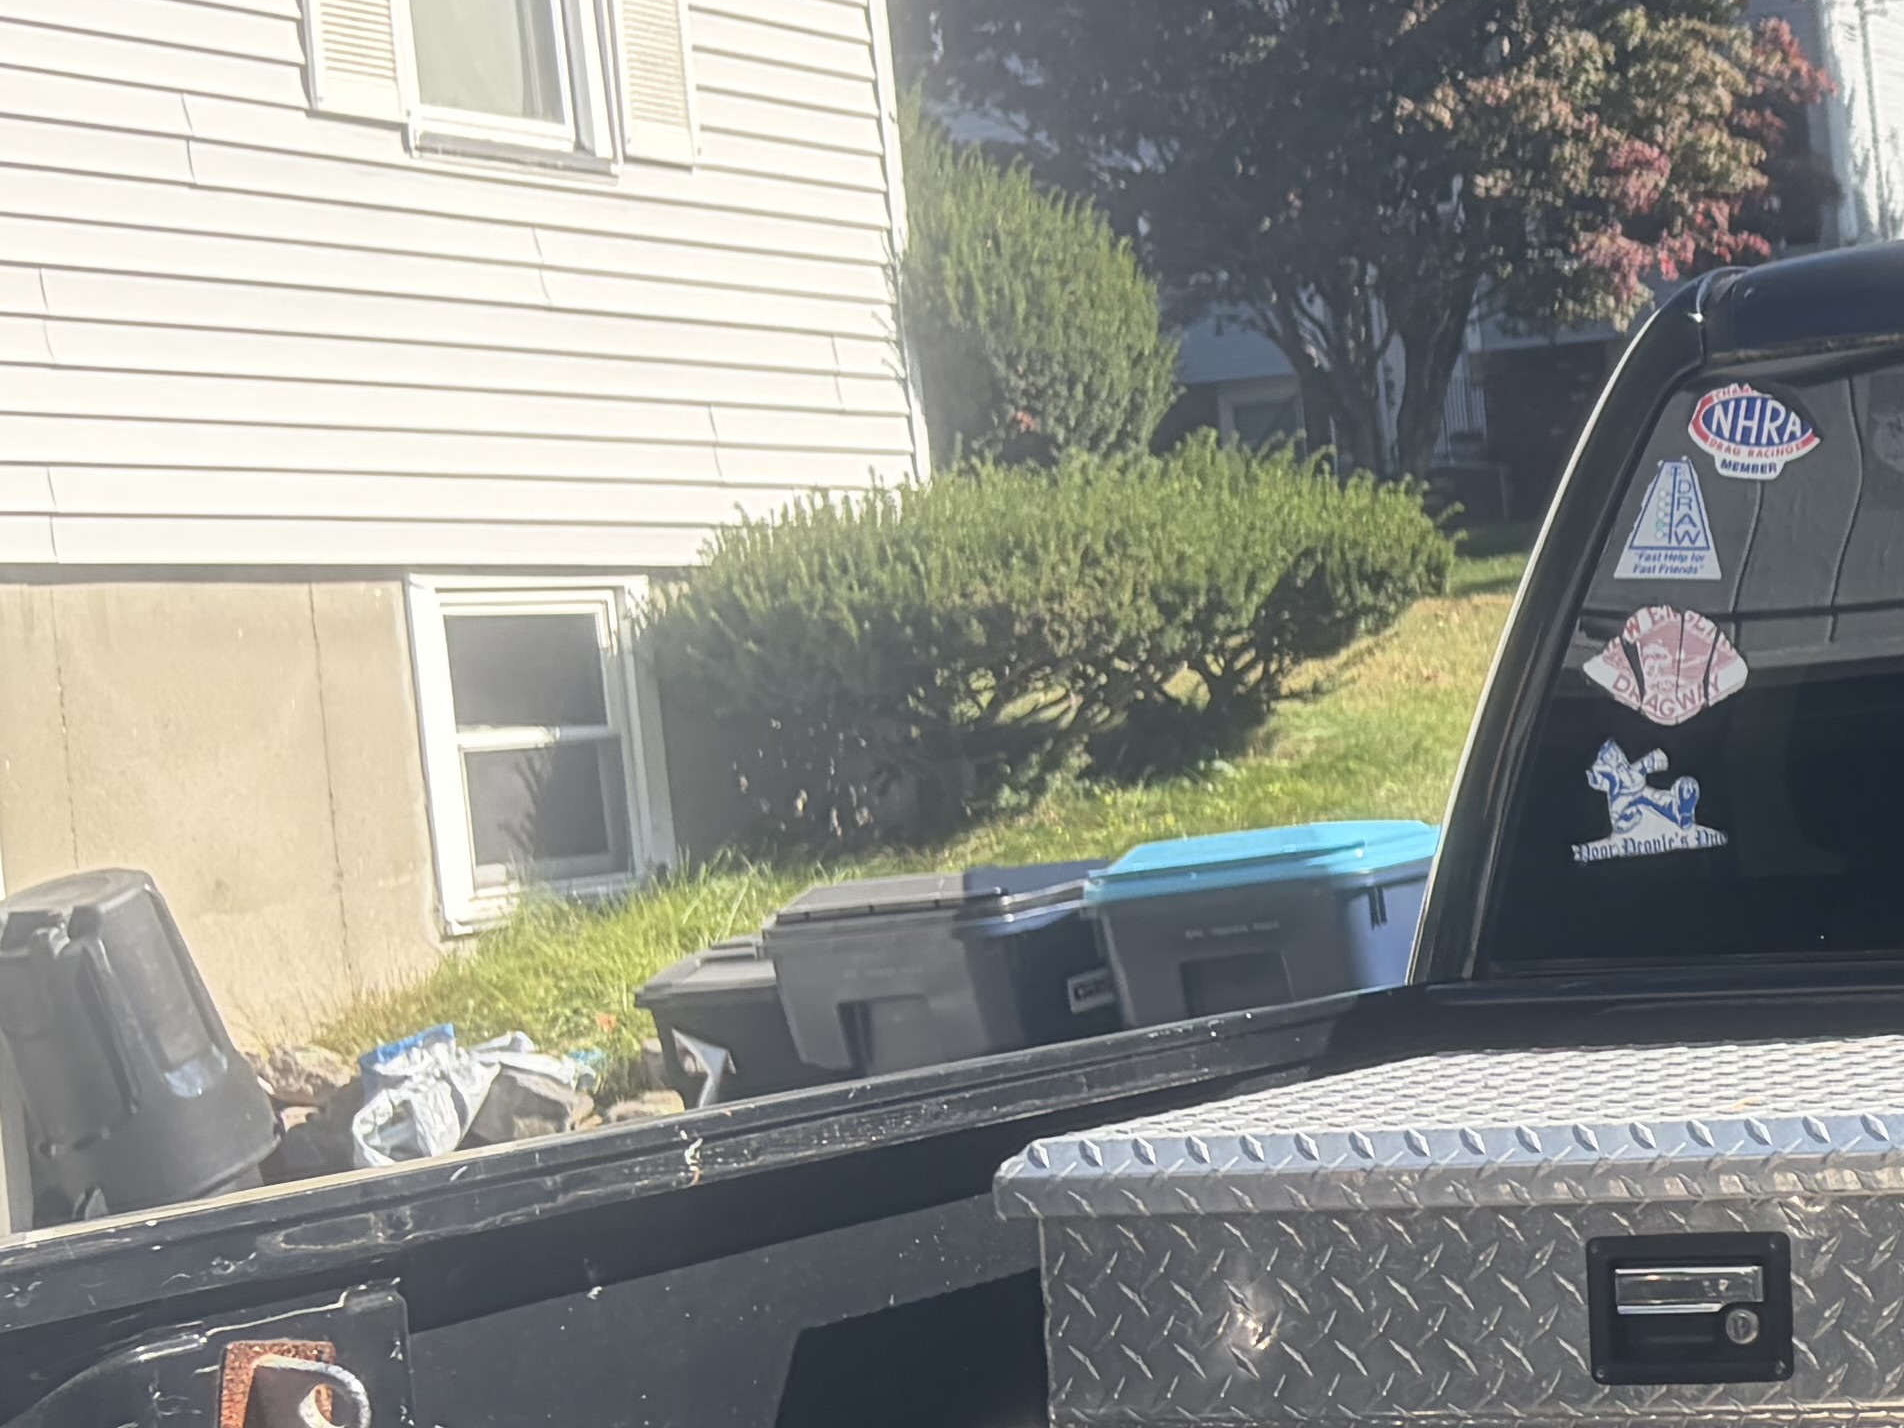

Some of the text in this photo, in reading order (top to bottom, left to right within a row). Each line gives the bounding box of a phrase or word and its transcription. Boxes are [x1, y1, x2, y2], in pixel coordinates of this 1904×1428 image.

[1711, 398, 1802, 445] NHRA
[1720, 458, 1778, 475] MEMBER
[1674, 479, 1701, 546] DRAW
